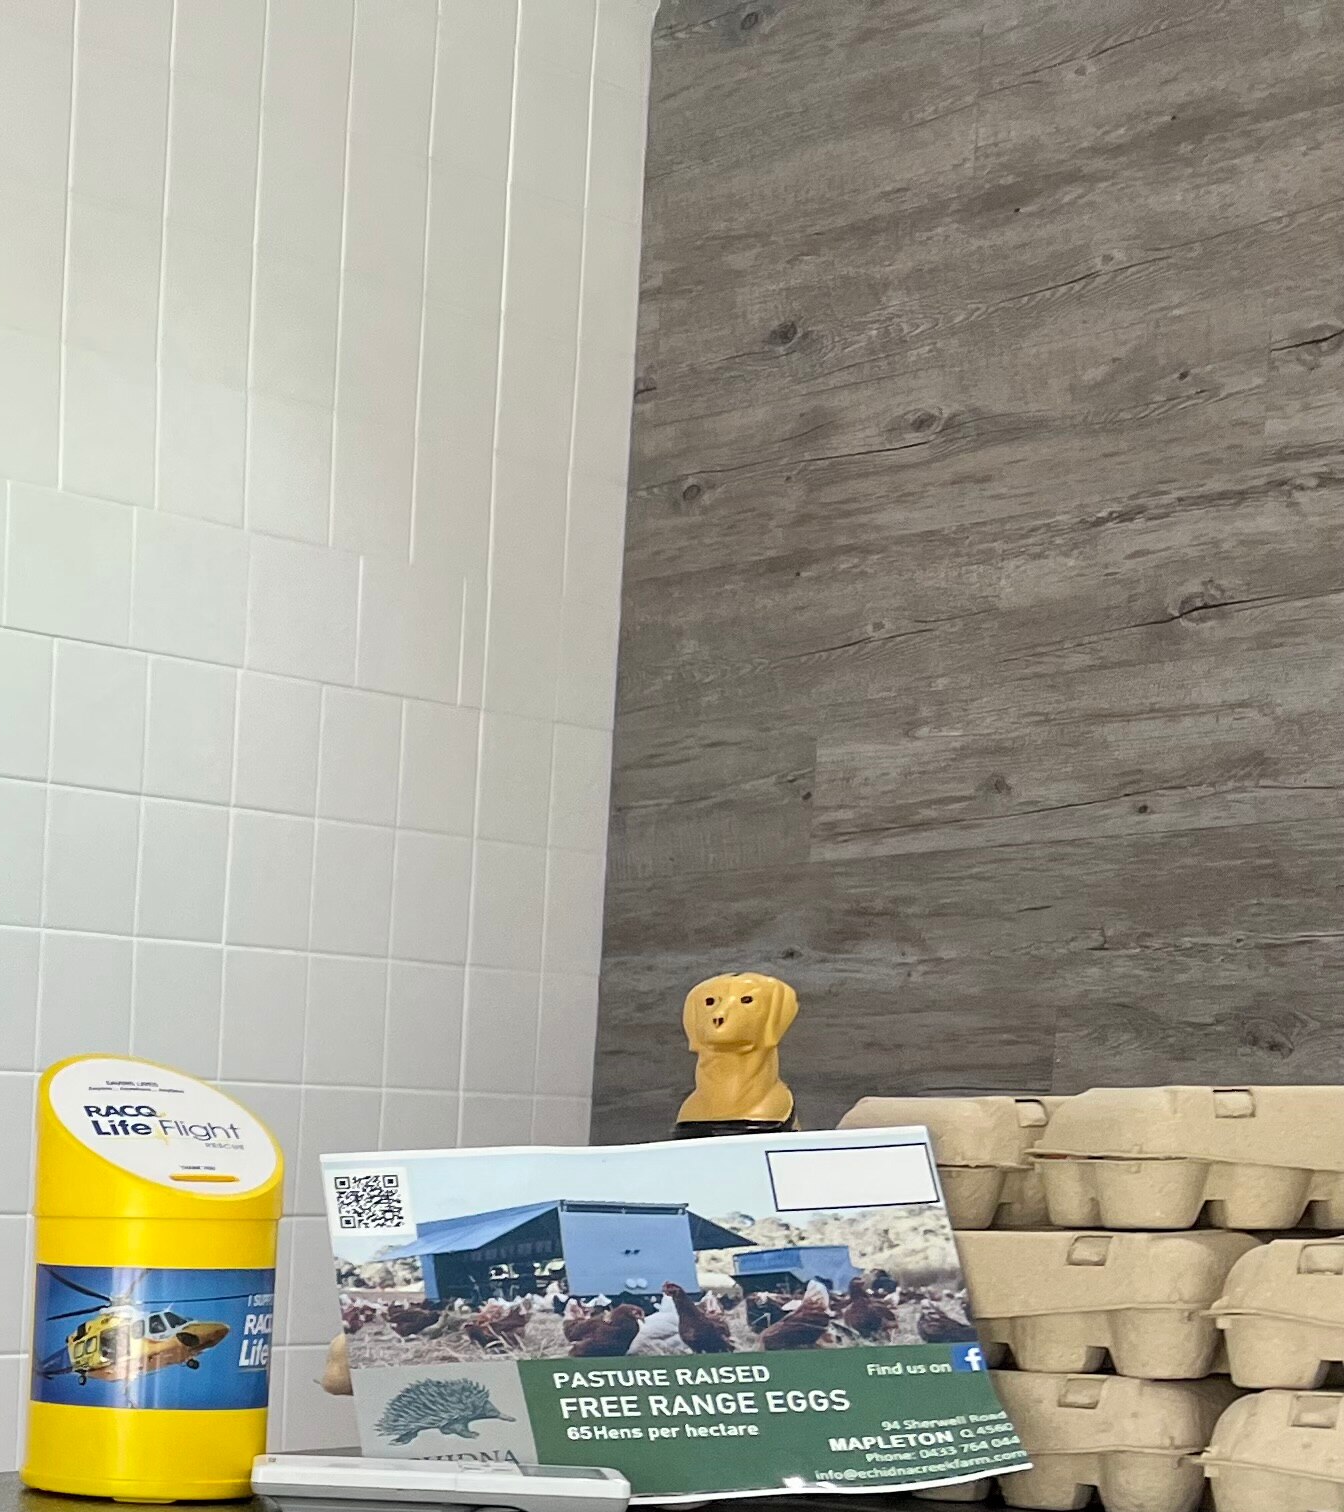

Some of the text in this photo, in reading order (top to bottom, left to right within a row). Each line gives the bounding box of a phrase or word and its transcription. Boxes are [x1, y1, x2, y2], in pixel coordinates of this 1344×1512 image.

[84, 1105, 157, 1118] RACQ
[91, 1119, 241, 1142] Life Flight
[239, 1337, 270, 1367] Life
[553, 1365, 770, 1389] PASTURE RAISED
[866, 1362, 953, 1377] Find us on
[560, 1389, 851, 1419] FREE RANGE EGGS
[648, 1426, 680, 1442] per
[685, 1423, 759, 1439] hectare
[881, 1411, 1008, 1431] 94 Sherwell Road
[828, 1430, 955, 1452] MAPLETON
[960, 1428, 976, 1439] Q
[866, 1451, 917, 1463] Phone:
[919, 1446, 958, 1459] 0433
[991, 1436, 1021, 1448] 044
[814, 1449, 1028, 1481] info@echidnacreekfarm.com
